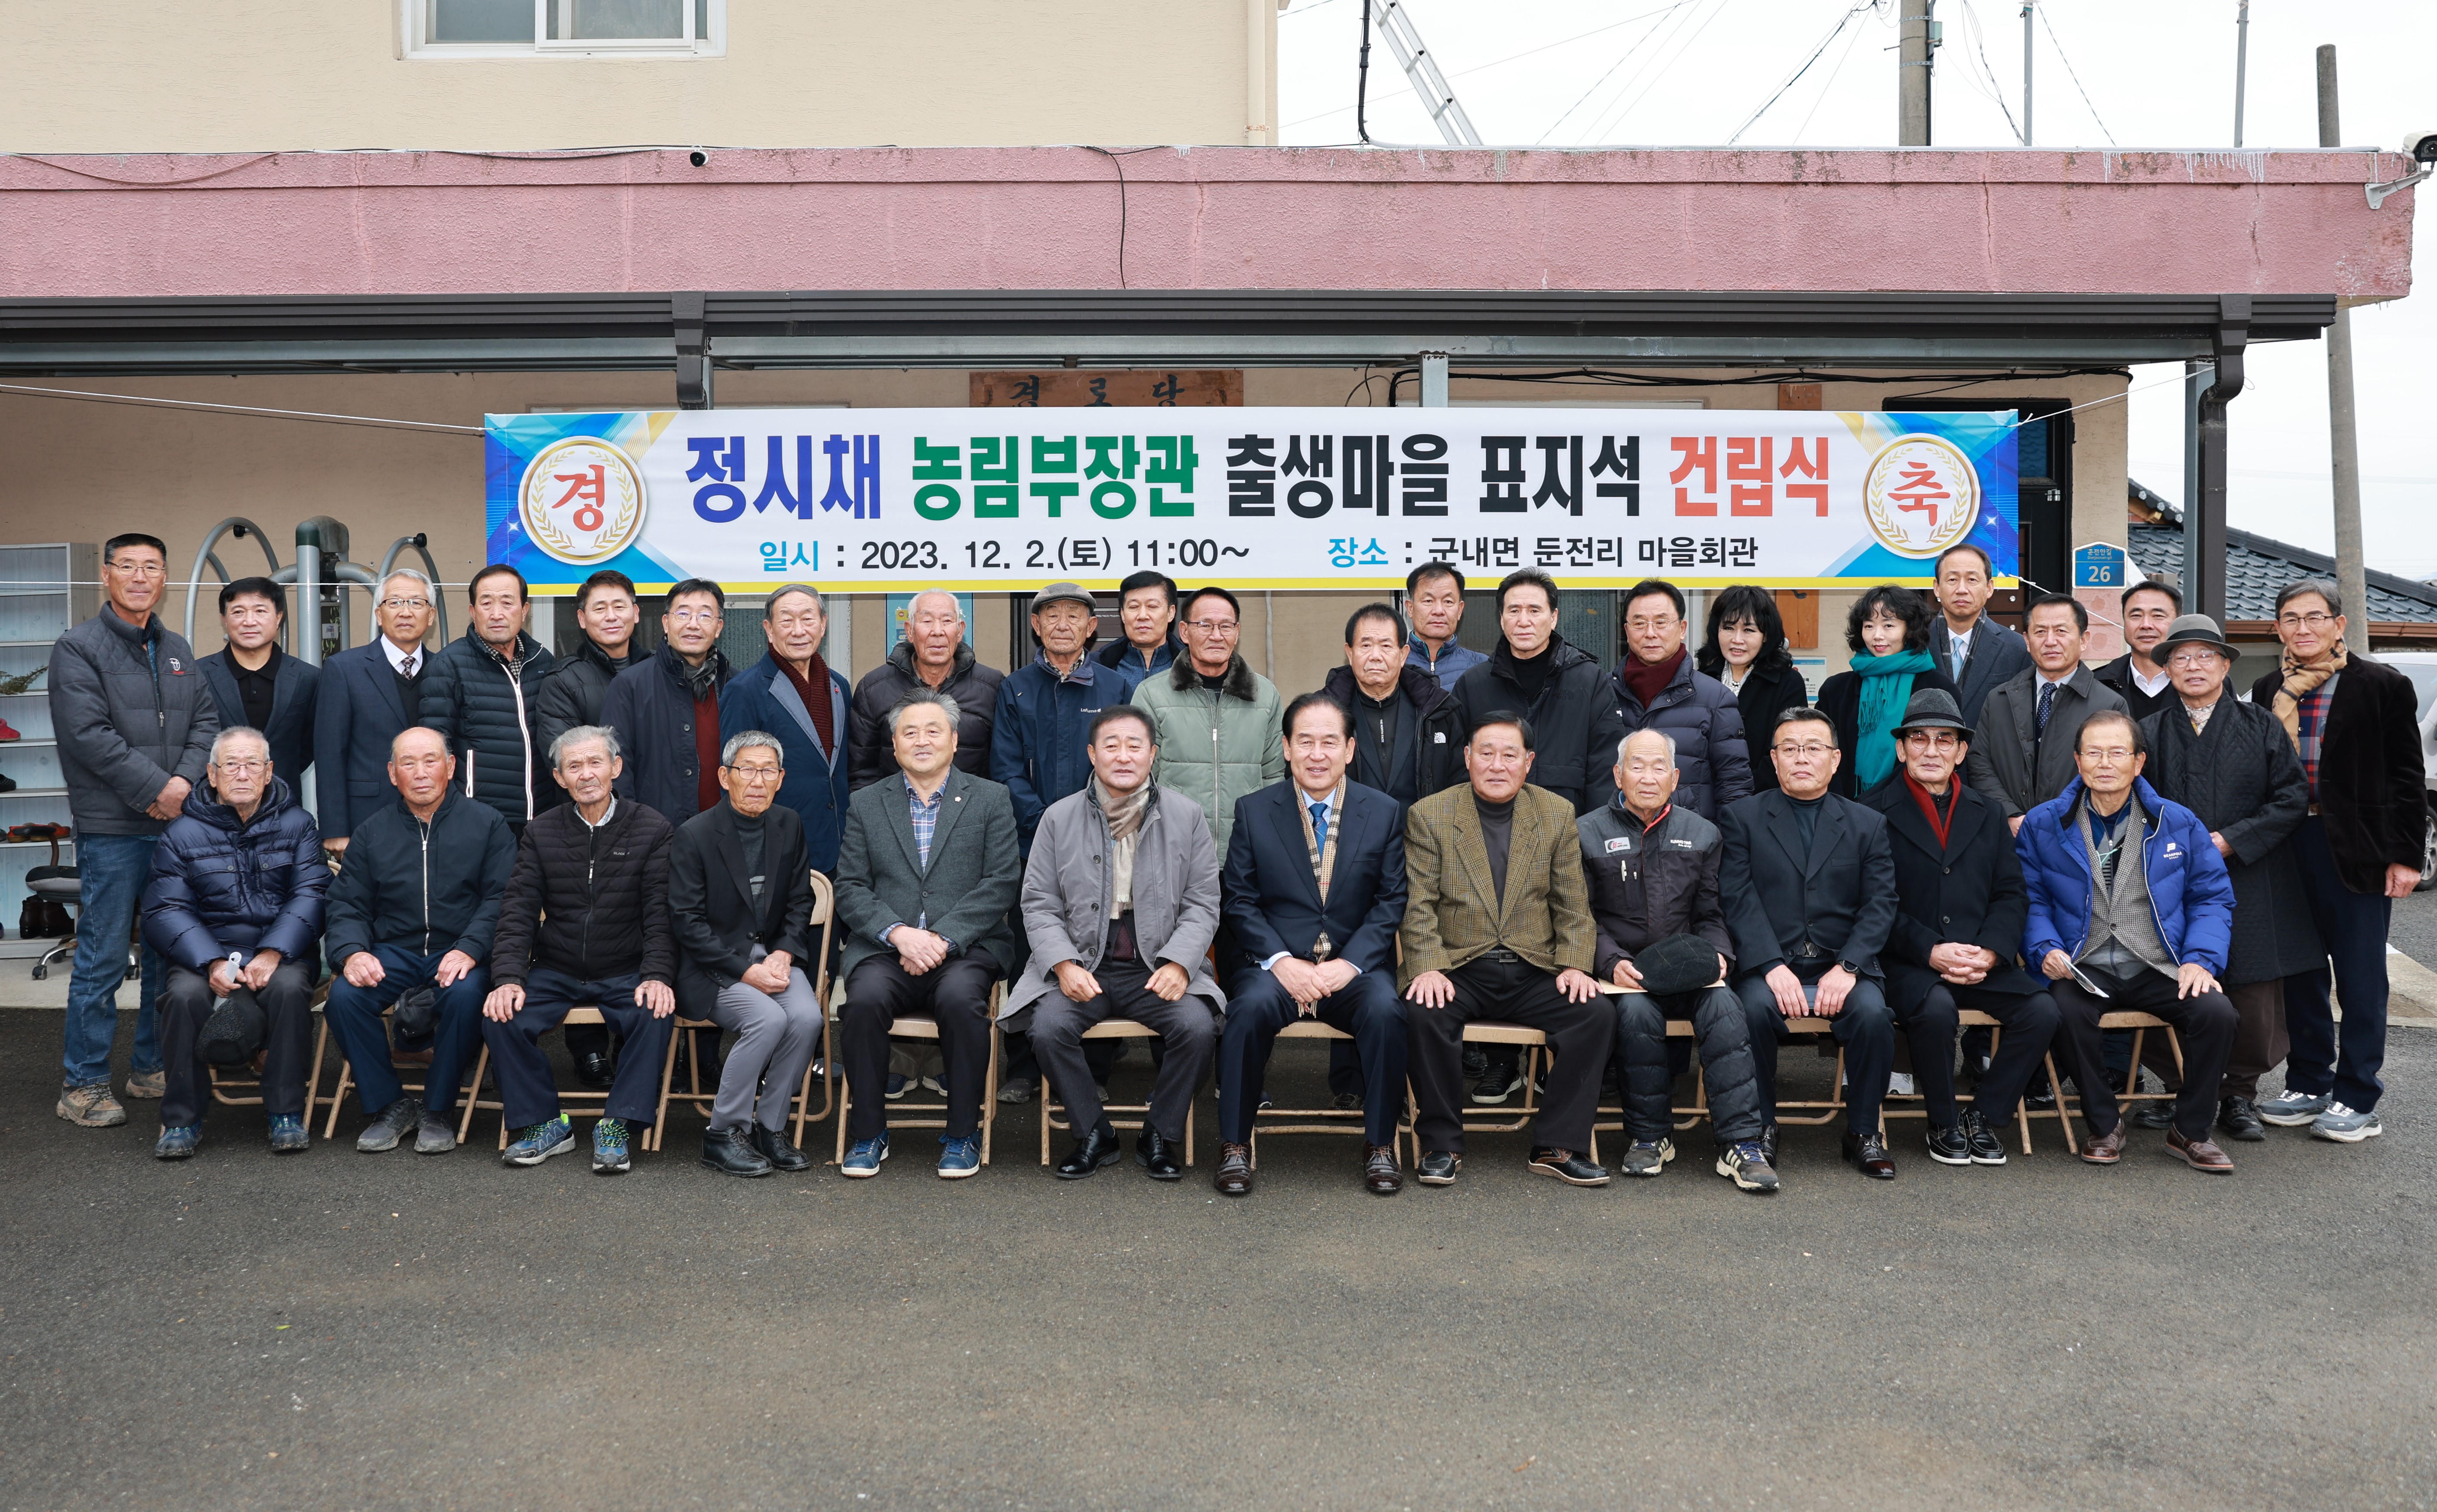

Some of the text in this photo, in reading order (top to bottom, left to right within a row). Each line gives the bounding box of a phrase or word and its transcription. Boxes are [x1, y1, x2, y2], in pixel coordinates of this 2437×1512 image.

[552, 464, 605, 532] 경
[685, 433, 1829, 523] 정시채 농림부장관 출생마을 표지석 건립식
[1887, 461, 1951, 527] 축
[759, 541, 818, 572] 일시
[861, 541, 947, 570] 2023.
[965, 540, 1010, 569] 12.
[1026, 537, 1111, 571] 2.(토)
[1127, 539, 1249, 567] 11:00~
[1327, 537, 1389, 568] 장소
[1428, 537, 1519, 567] 군내면
[1533, 537, 1623, 567] 둔전리
[1639, 537, 1758, 567] 마을회관
[2088, 565, 2111, 582] 26
